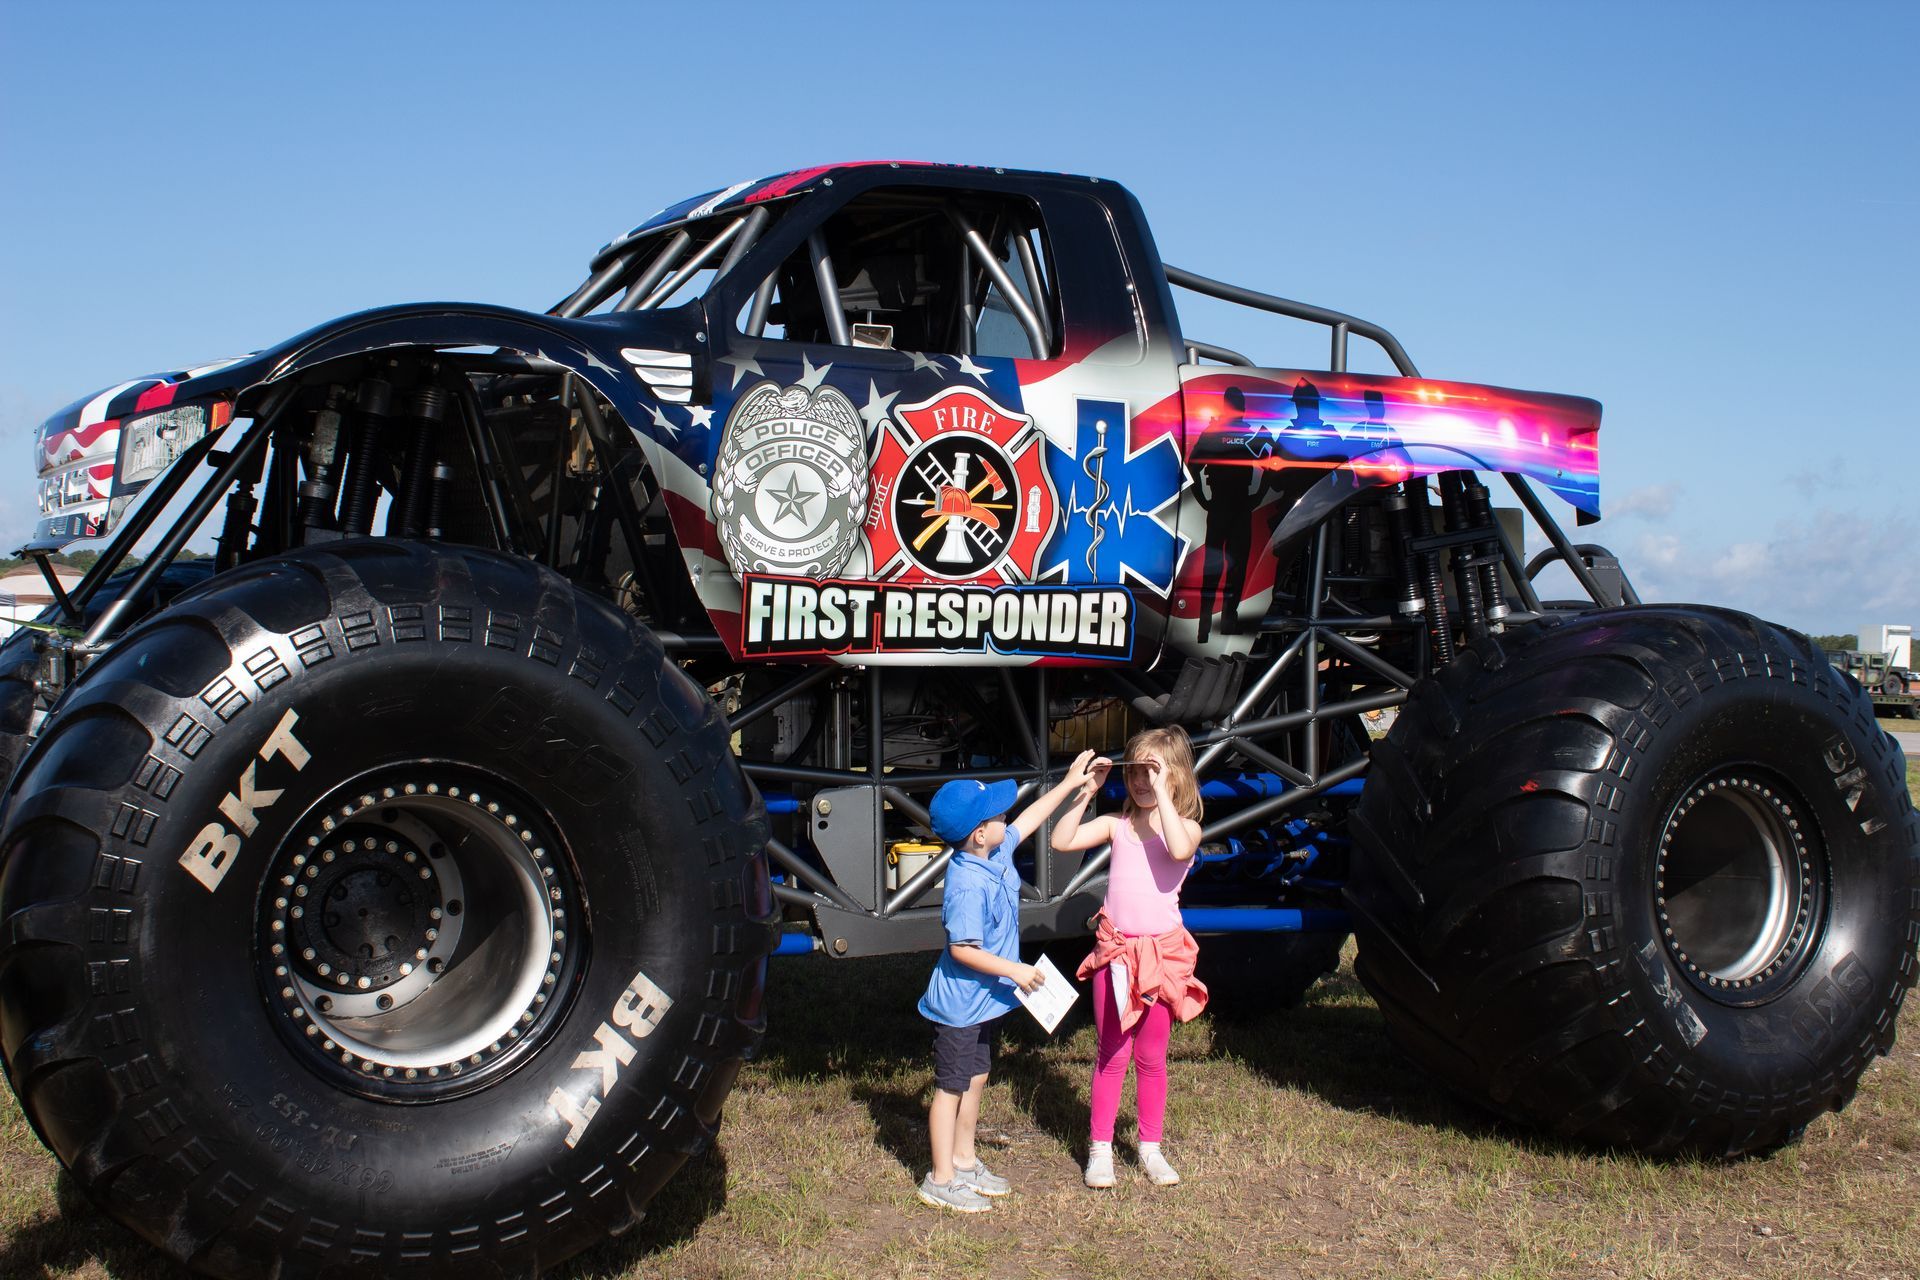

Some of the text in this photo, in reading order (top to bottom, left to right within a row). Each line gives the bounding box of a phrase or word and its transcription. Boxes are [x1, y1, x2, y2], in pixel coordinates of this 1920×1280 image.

[755, 422, 839, 445] POLICE
[932, 406, 996, 434] FIRE
[1222, 437, 1244, 445] POLICE
[1306, 440, 1319, 448] FIRE
[745, 444, 844, 478] OFFICER
[743, 532, 835, 557] SERVE & PROTECT
[748, 581, 1128, 649] FIRST RESPONDER
[178, 708, 312, 893] BKT
[547, 971, 676, 1150] BKT
